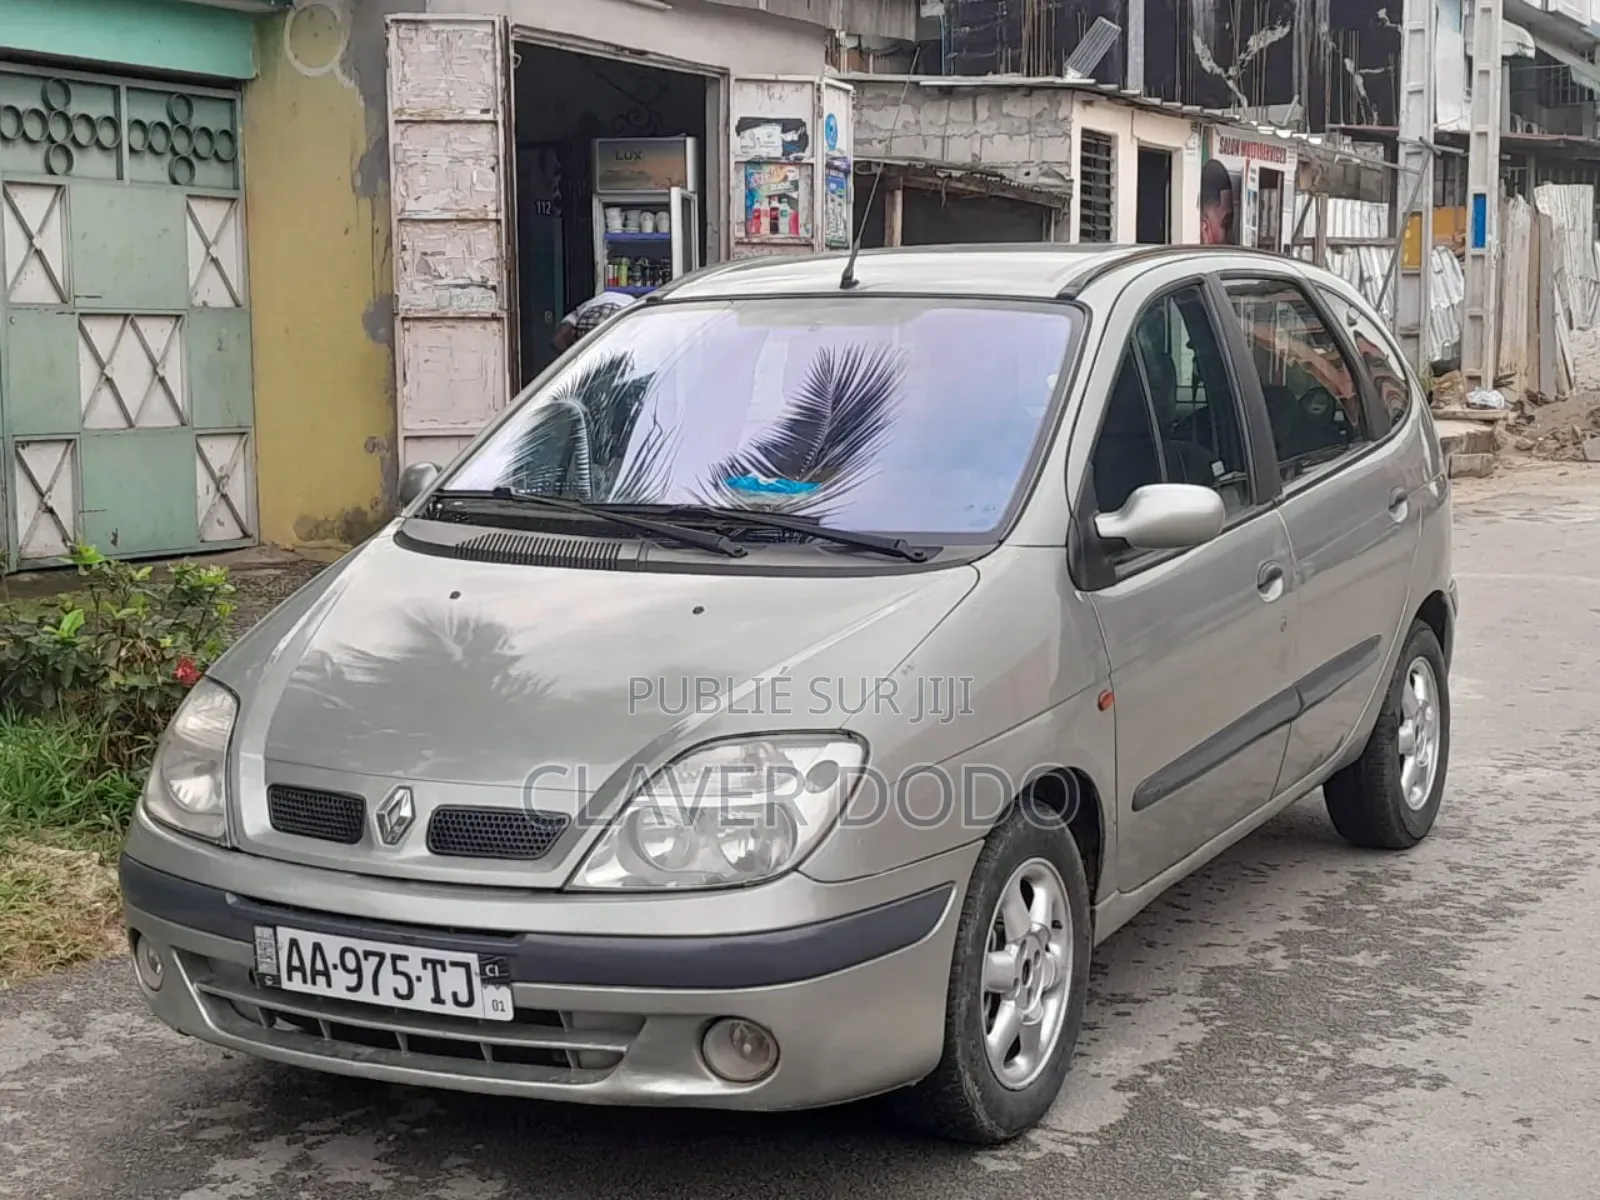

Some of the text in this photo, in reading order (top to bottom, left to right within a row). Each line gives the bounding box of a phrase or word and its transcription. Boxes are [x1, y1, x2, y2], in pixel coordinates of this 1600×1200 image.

[1219, 136, 1240, 157] SALON
[615, 150, 643, 161] LUX
[491, 999, 506, 1013] 01
